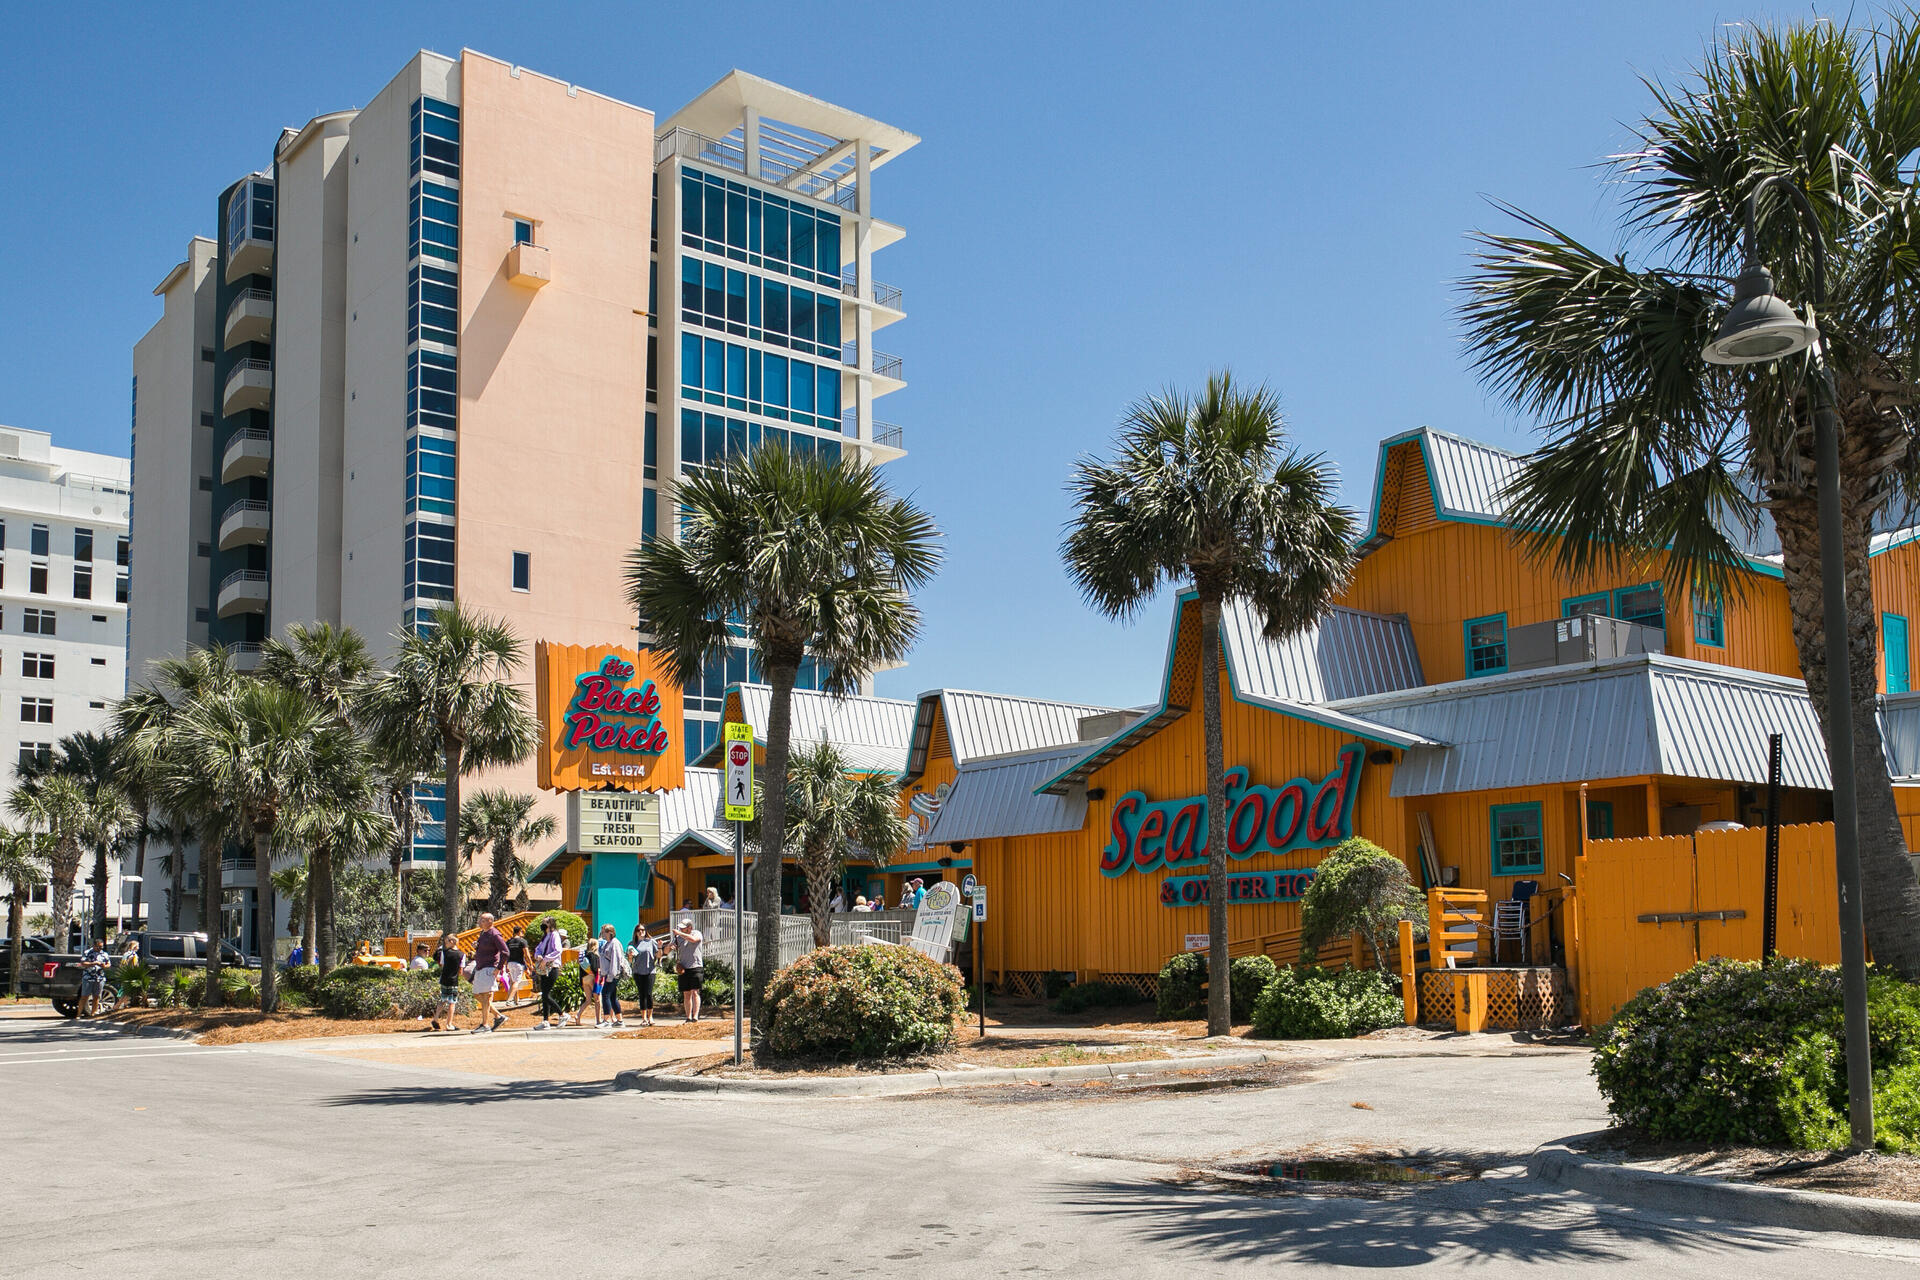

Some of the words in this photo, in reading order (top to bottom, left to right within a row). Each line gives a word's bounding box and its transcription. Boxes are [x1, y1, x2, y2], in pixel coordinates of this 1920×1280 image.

[605, 658, 635, 678] the
[578, 675, 661, 715] Back
[570, 711, 669, 752] Porch
[730, 725, 749, 733] STATE
[730, 750, 749, 761] STOP
[592, 763, 616, 776] Est.
[620, 765, 645, 777] 1974
[591, 799, 647, 812] BEAUTIFUL
[606, 811, 633, 823] VIEW
[602, 823, 635, 834] FRESH
[593, 835, 643, 847] SEAFOOD
[1160, 881, 1175, 903] &
[1181, 876, 1267, 902] OYTER
